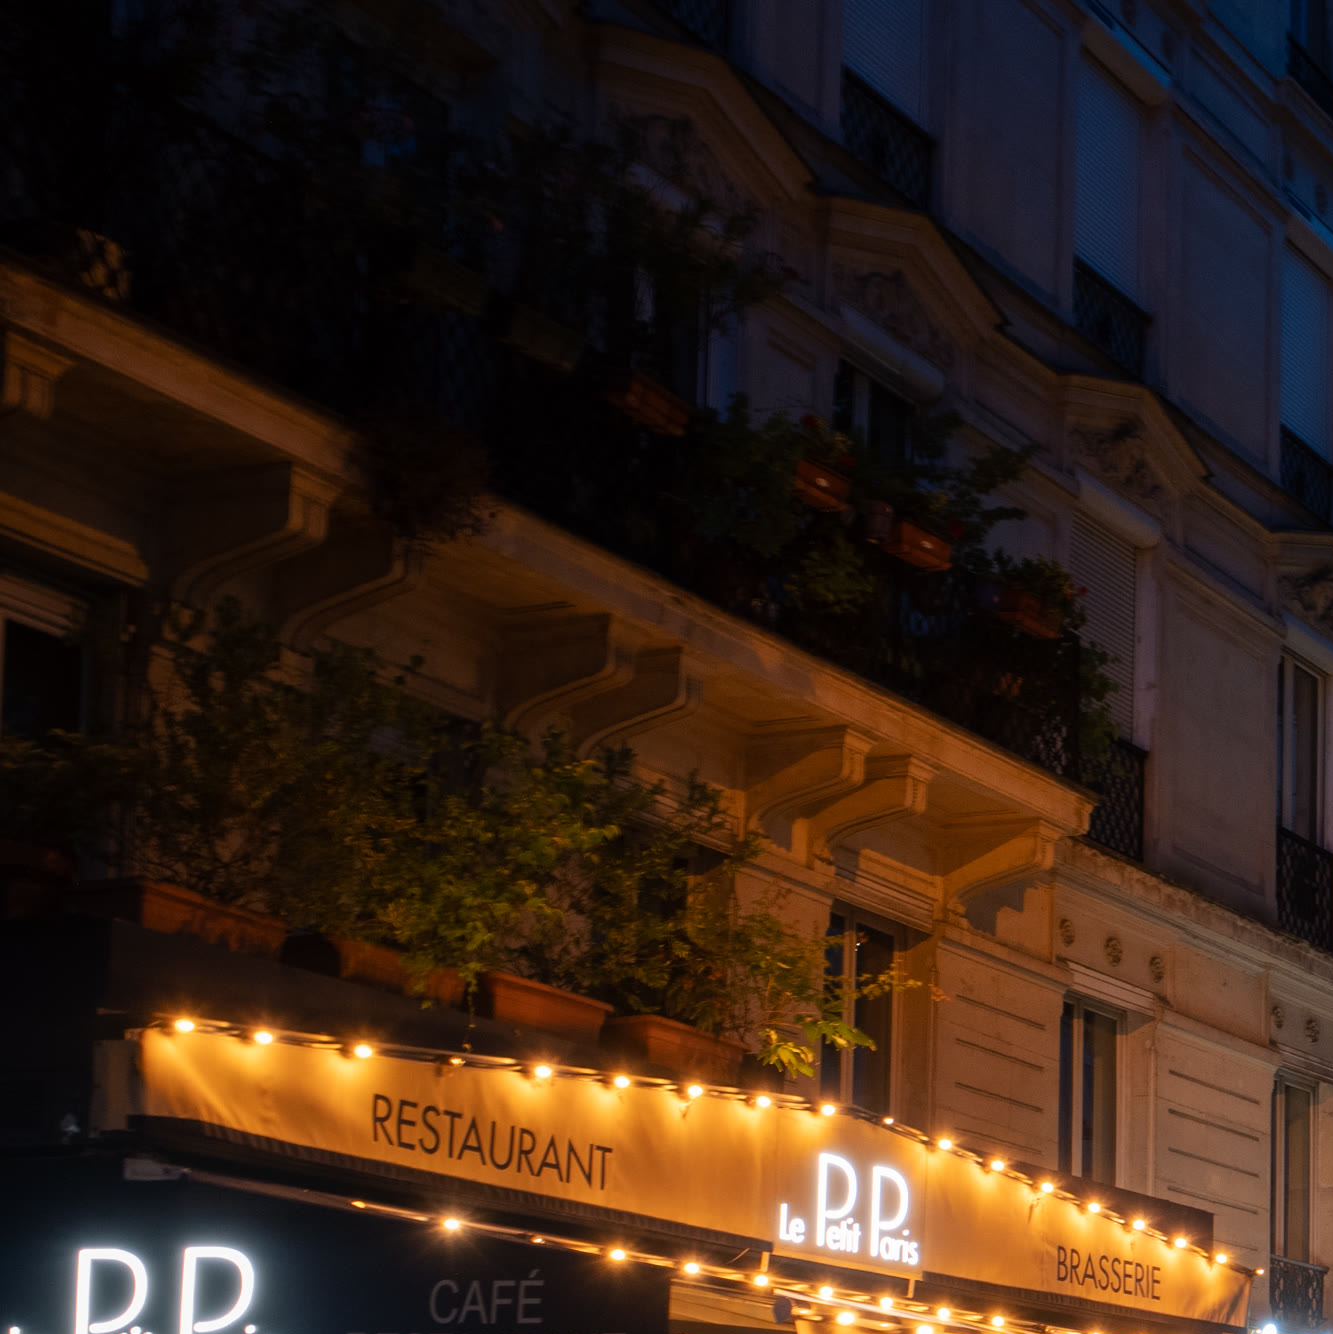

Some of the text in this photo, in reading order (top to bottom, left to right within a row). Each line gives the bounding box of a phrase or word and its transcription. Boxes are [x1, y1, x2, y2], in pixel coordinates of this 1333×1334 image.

[372, 1094, 613, 1191] RESTAURANT
[779, 1152, 919, 1265] Le Petit Paris
[428, 1269, 544, 1325] CAFÉ
[1056, 1245, 1161, 1300] BRASSERIE
